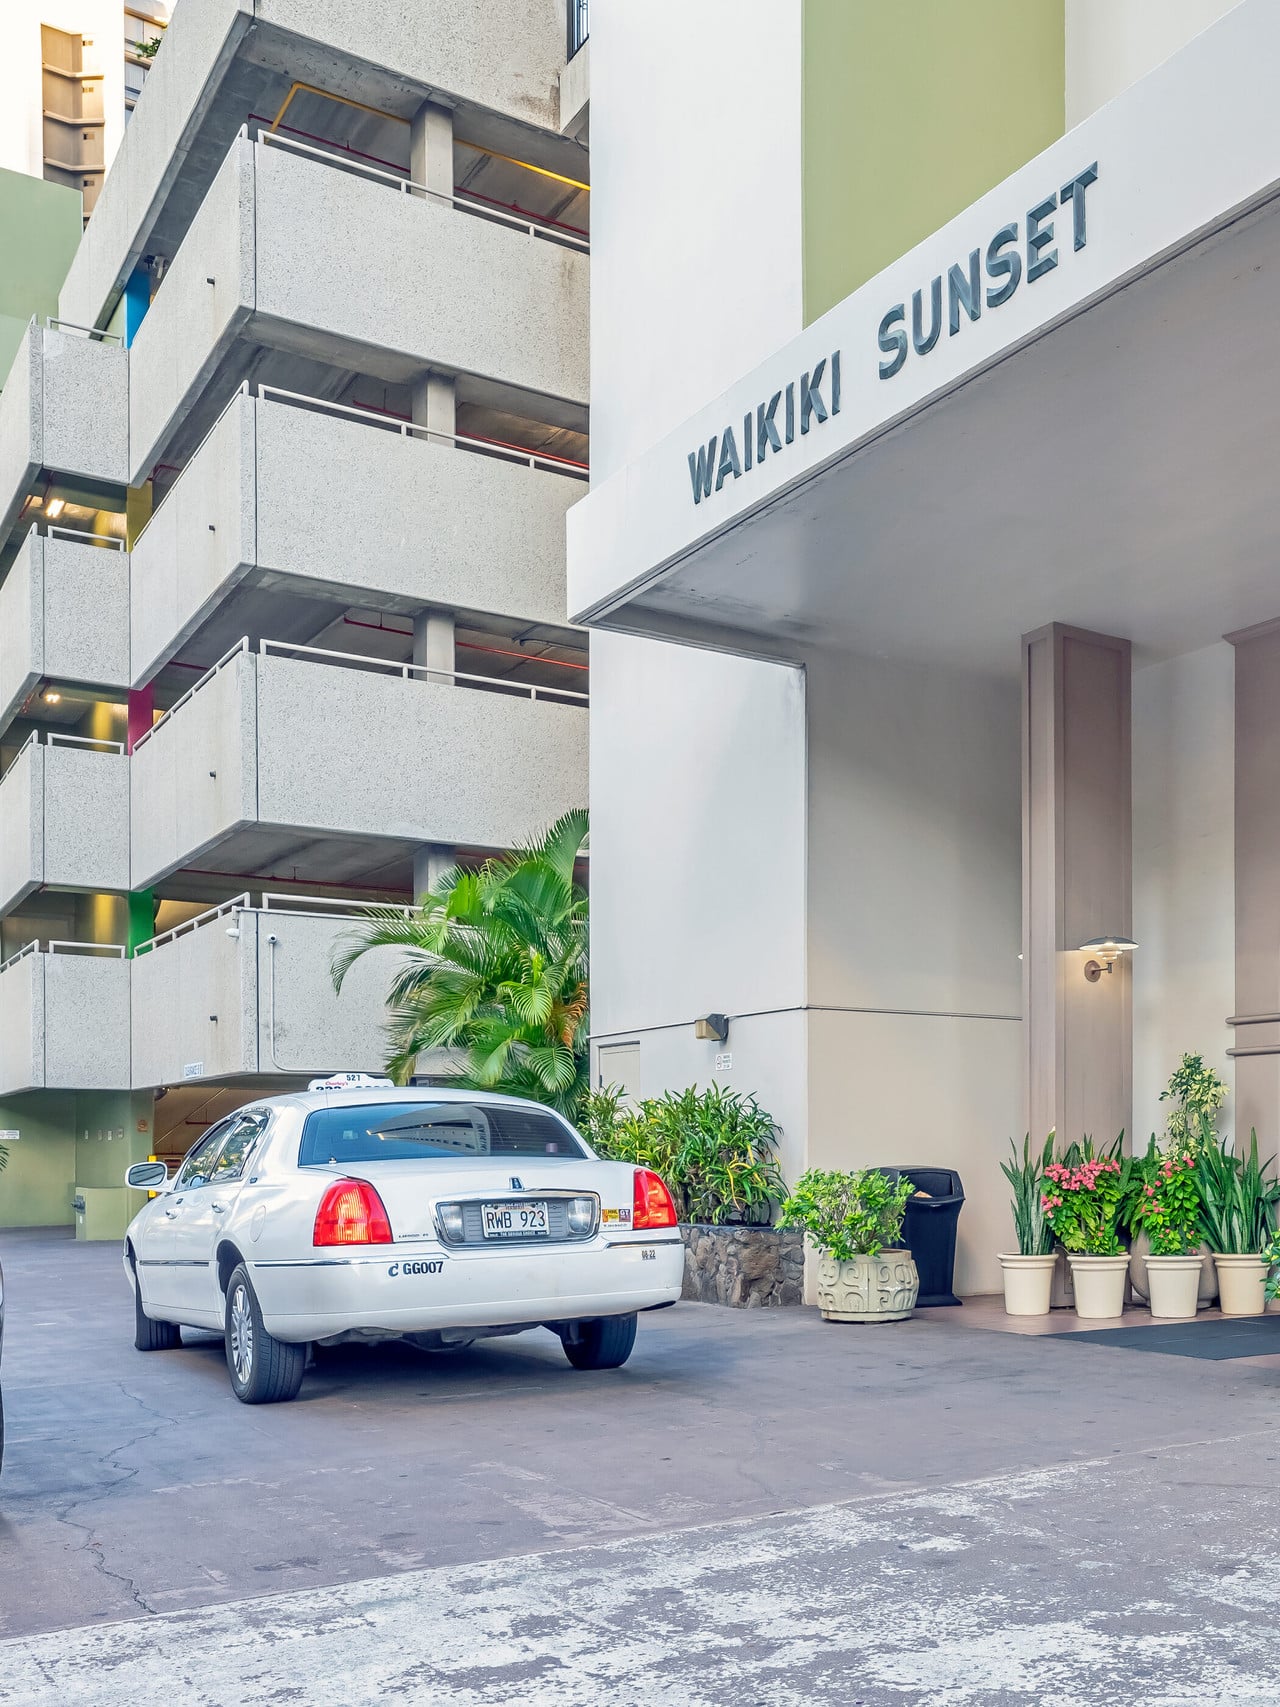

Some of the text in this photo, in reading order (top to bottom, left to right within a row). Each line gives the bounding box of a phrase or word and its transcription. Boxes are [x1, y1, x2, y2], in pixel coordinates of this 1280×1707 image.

[687, 160, 1099, 505] WAIKIKI SUNSET
[486, 1210, 546, 1229] RWB 923
[402, 1261, 444, 1275] GG007
